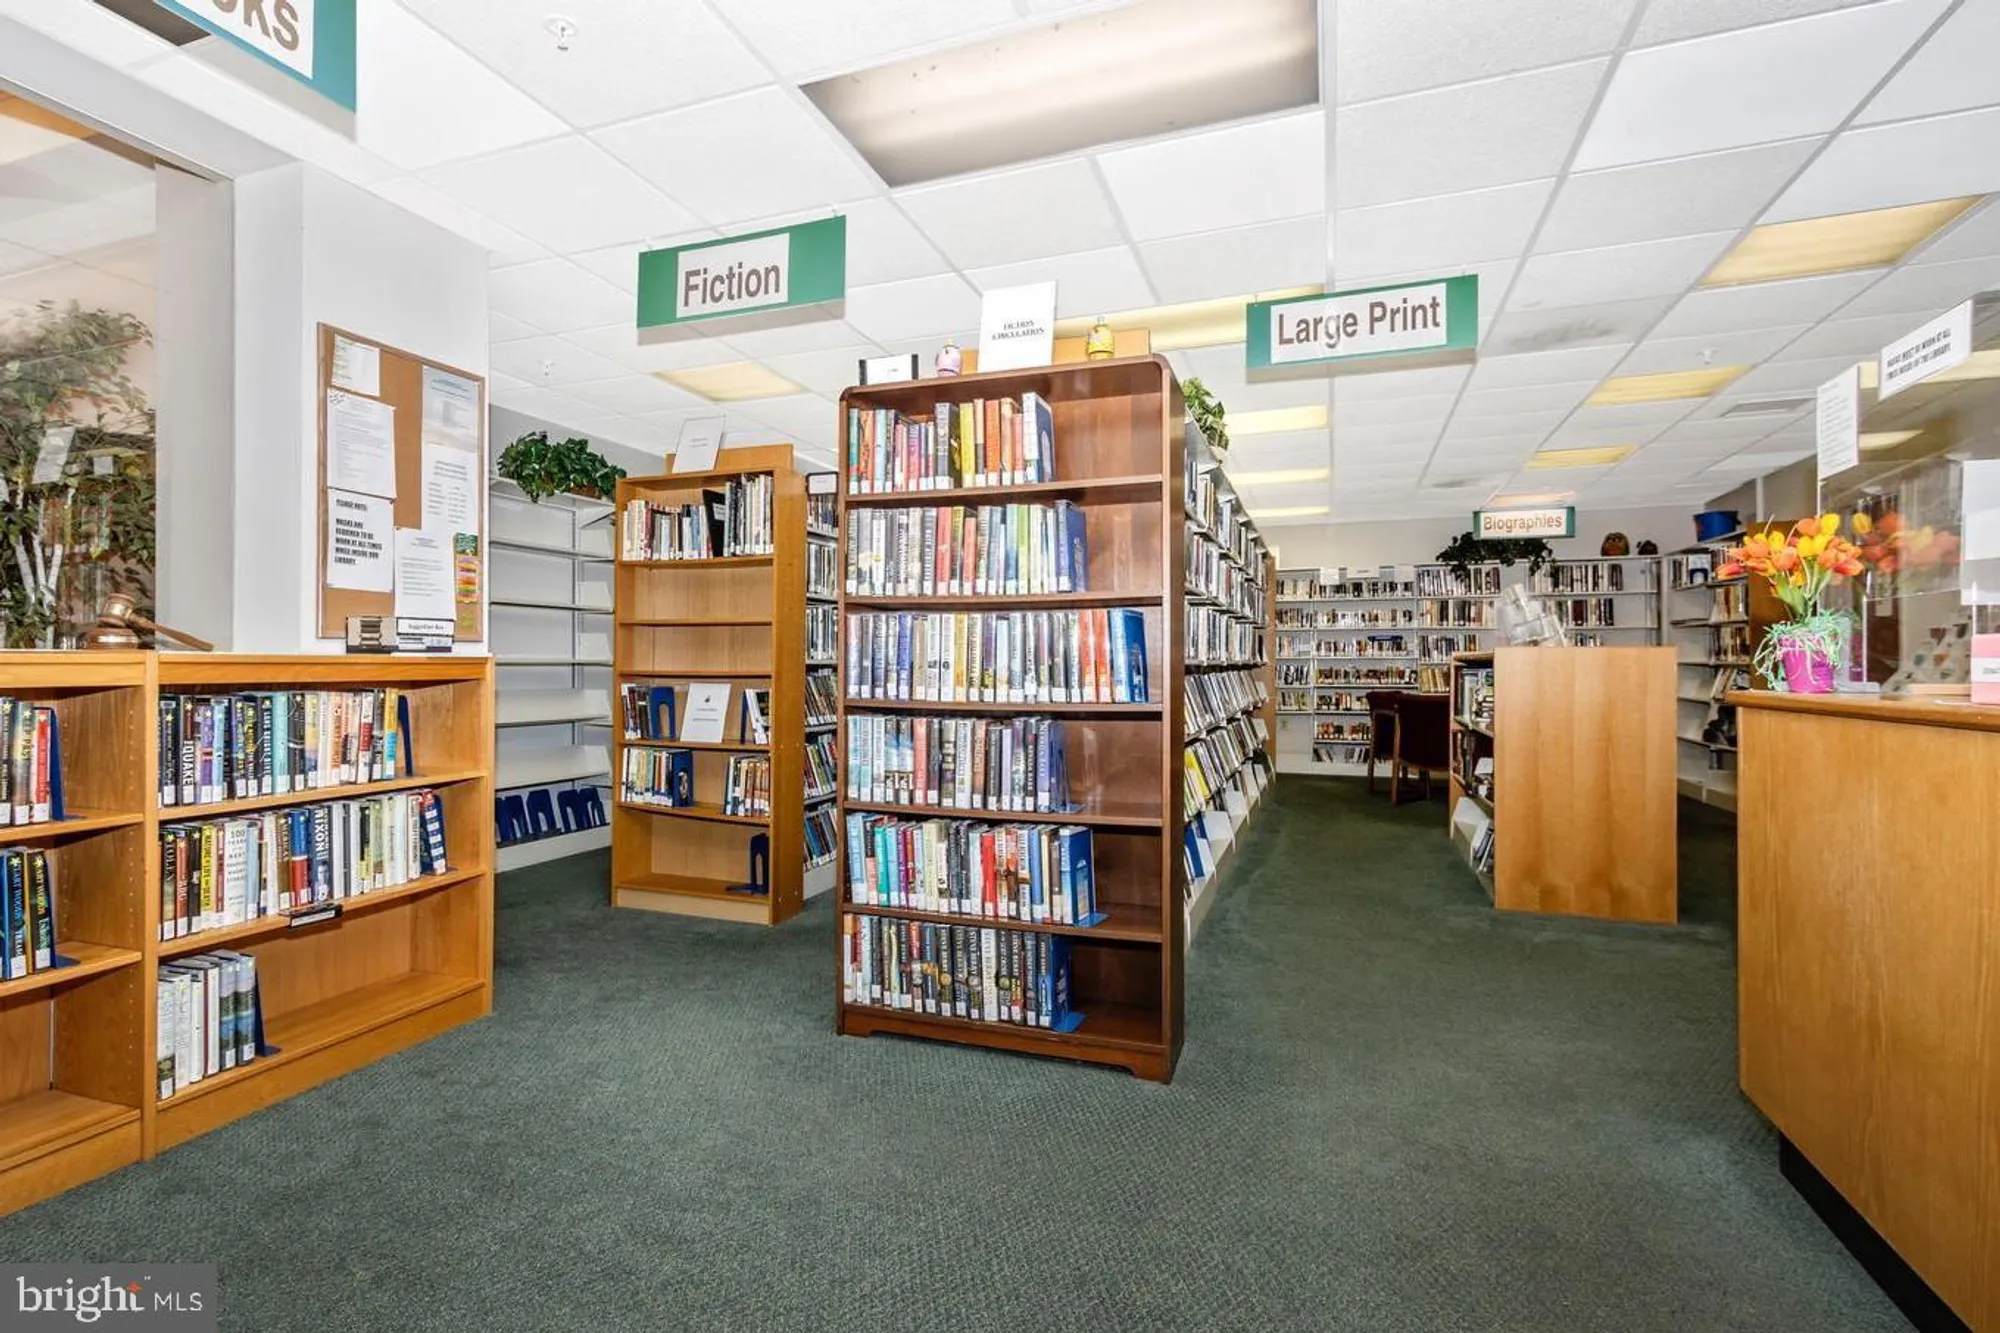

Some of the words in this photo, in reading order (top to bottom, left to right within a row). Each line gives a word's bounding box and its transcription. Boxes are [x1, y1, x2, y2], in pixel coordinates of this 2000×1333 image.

[212, 0, 300, 51] KS
[683, 262, 781, 307] Fiction
[1278, 311, 1359, 349] Large
[1369, 296, 1440, 336] Print
[1484, 514, 1563, 533] Biographies
[314, 809, 325, 851] NIXON
[970, 953, 978, 975] BERRY
